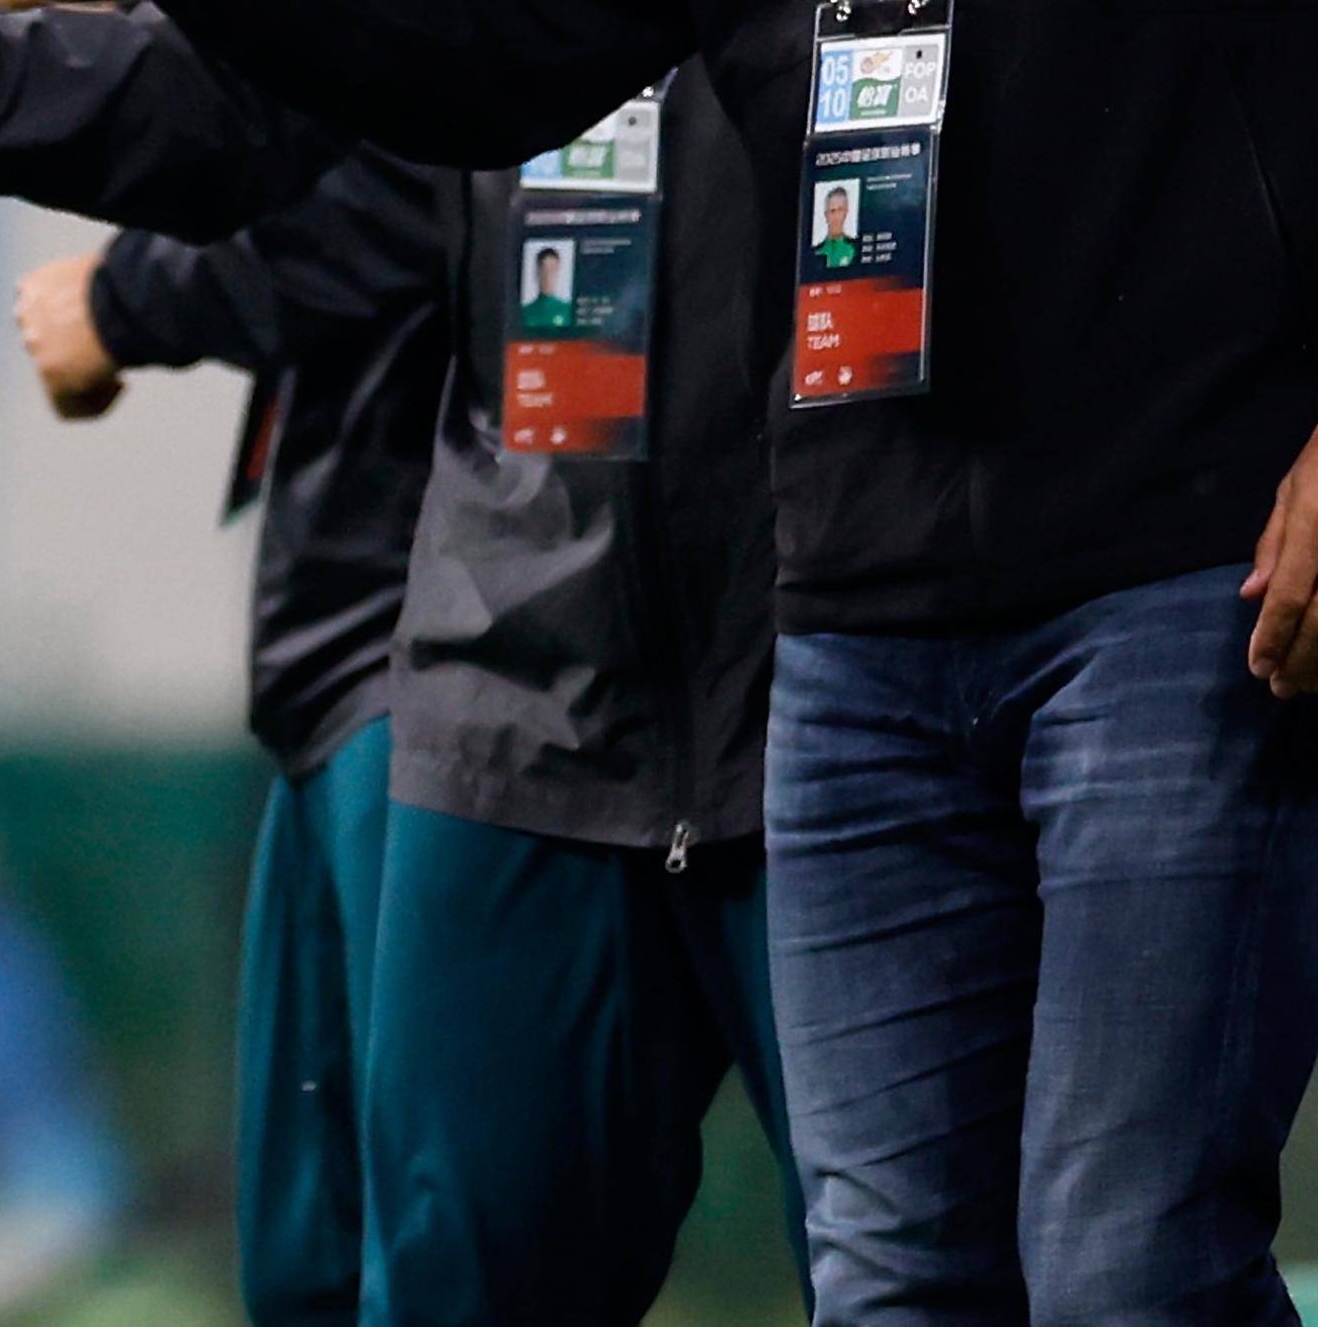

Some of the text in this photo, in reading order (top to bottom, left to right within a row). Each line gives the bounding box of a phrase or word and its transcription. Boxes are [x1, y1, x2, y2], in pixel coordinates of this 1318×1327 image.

[821, 56, 848, 85] 05
[904, 61, 937, 80] FOP
[819, 87, 846, 118] 10
[905, 86, 929, 104] OA
